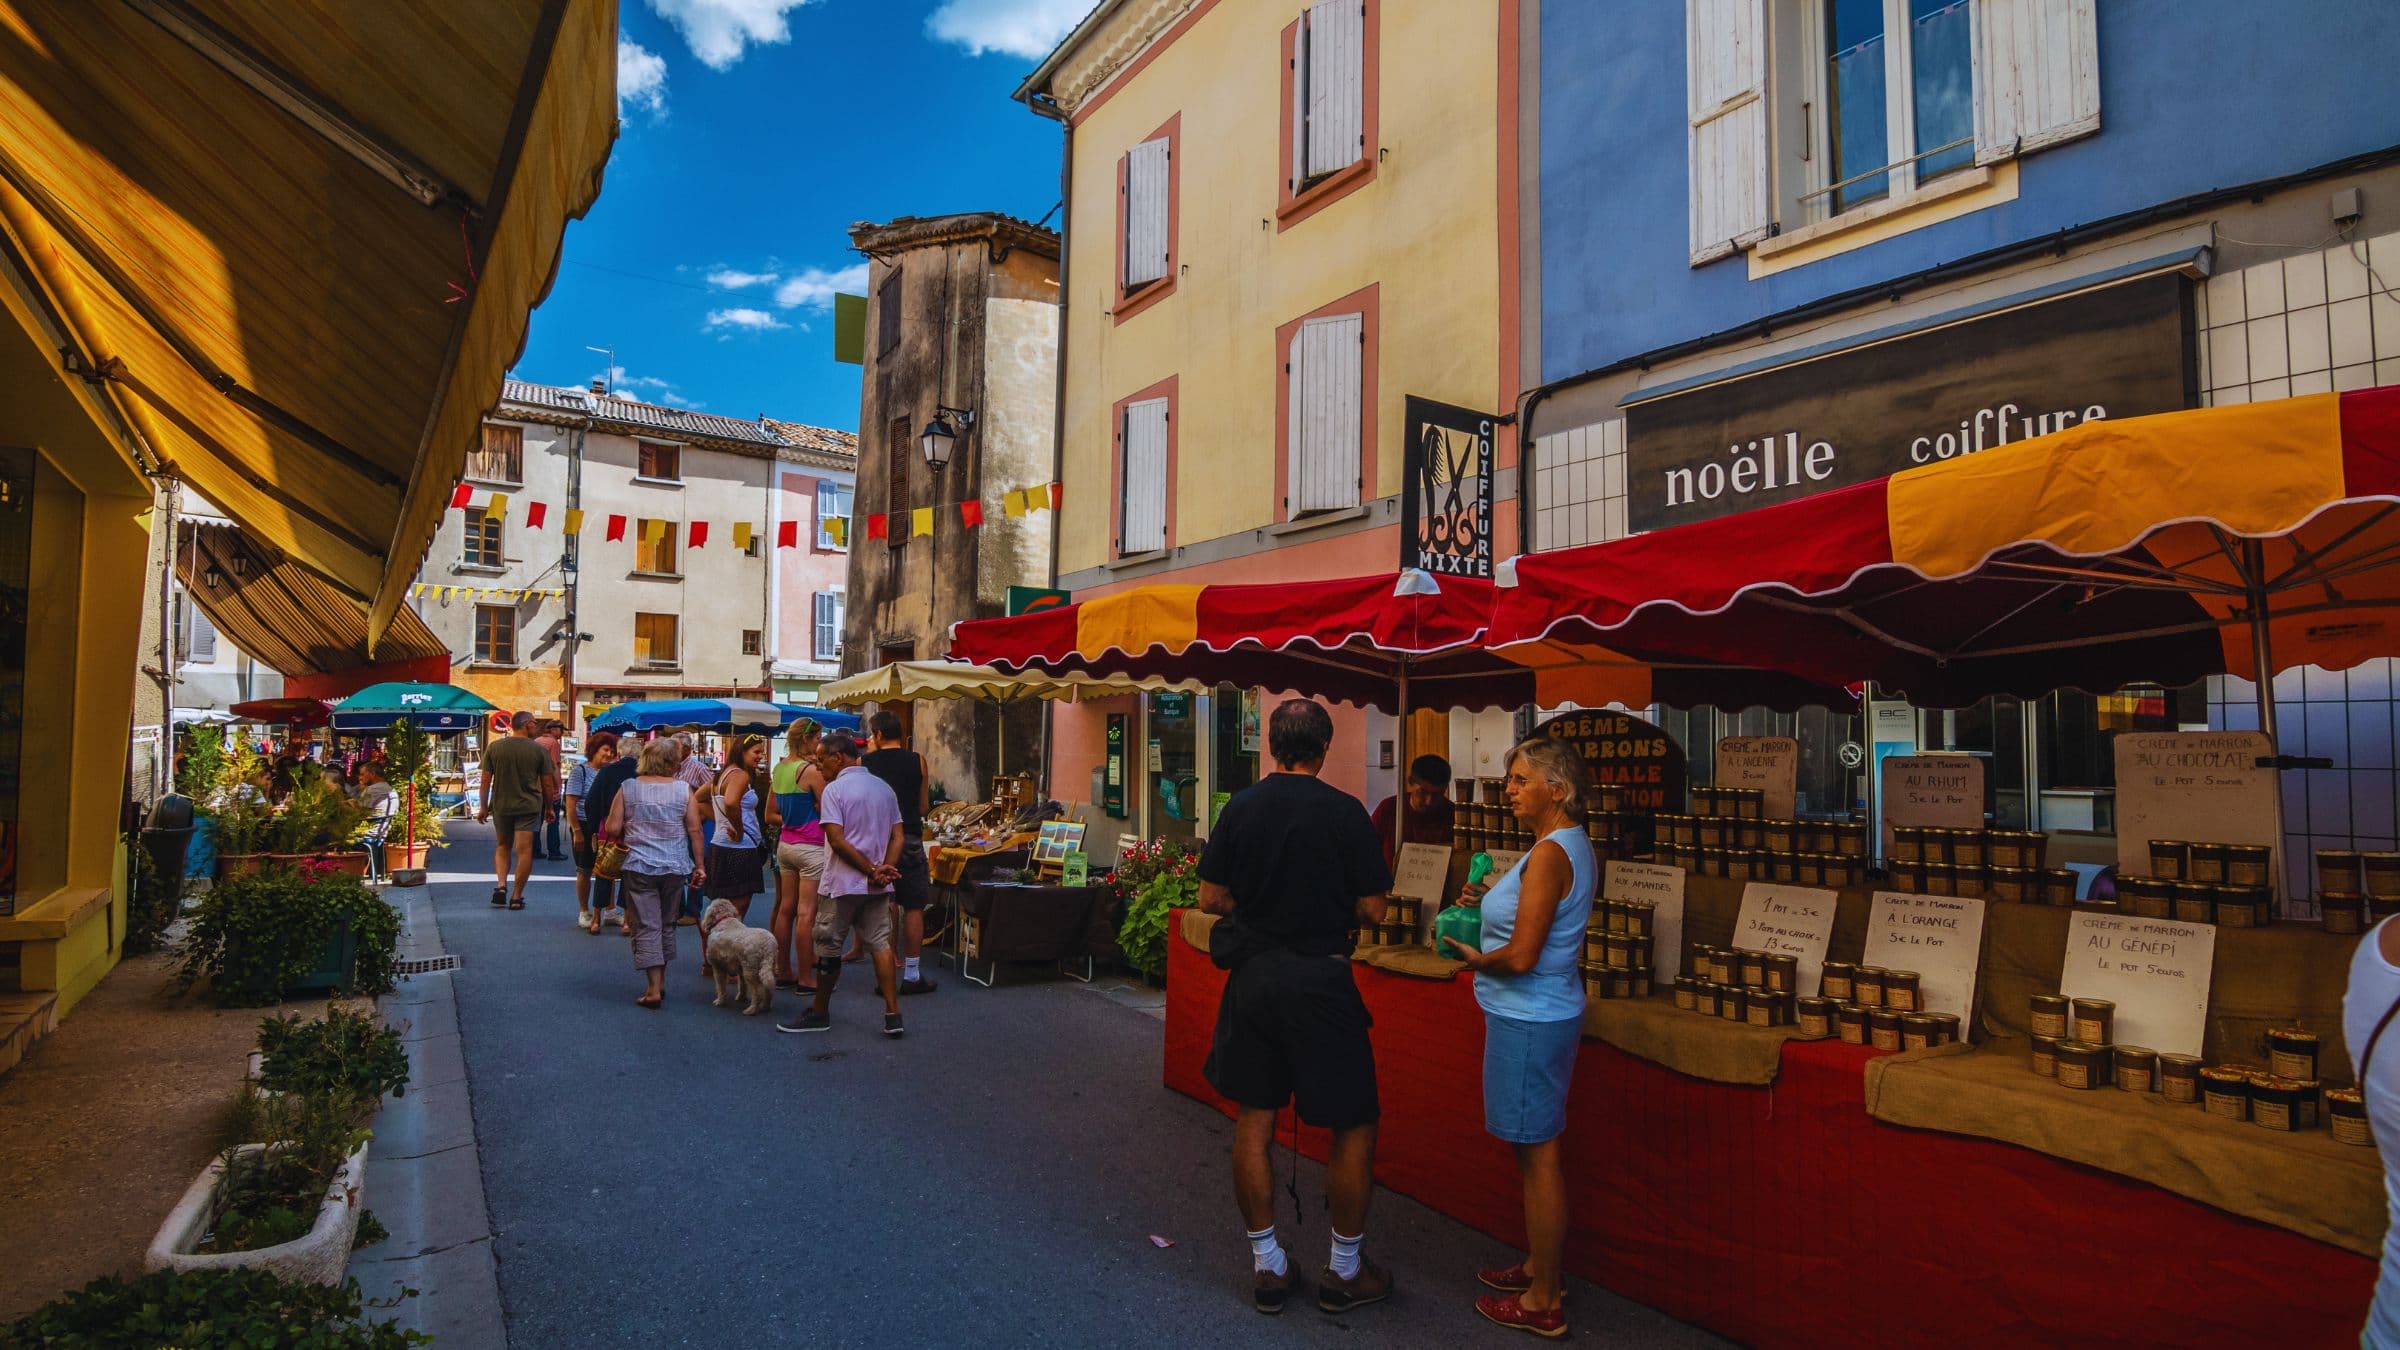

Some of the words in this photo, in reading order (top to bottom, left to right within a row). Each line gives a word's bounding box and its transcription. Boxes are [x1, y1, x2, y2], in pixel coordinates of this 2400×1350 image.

[1665, 432, 1835, 507] noëlle
[1911, 404, 2107, 463] coiffure
[1478, 420, 1490, 577] COIFFURE
[1419, 551, 1489, 577] MIXTE
[1571, 738, 1667, 759] ARRONS
[1928, 775, 1966, 789] RHUM
[2143, 925, 2195, 938] MARRON
[2088, 935, 2111, 950] AU
